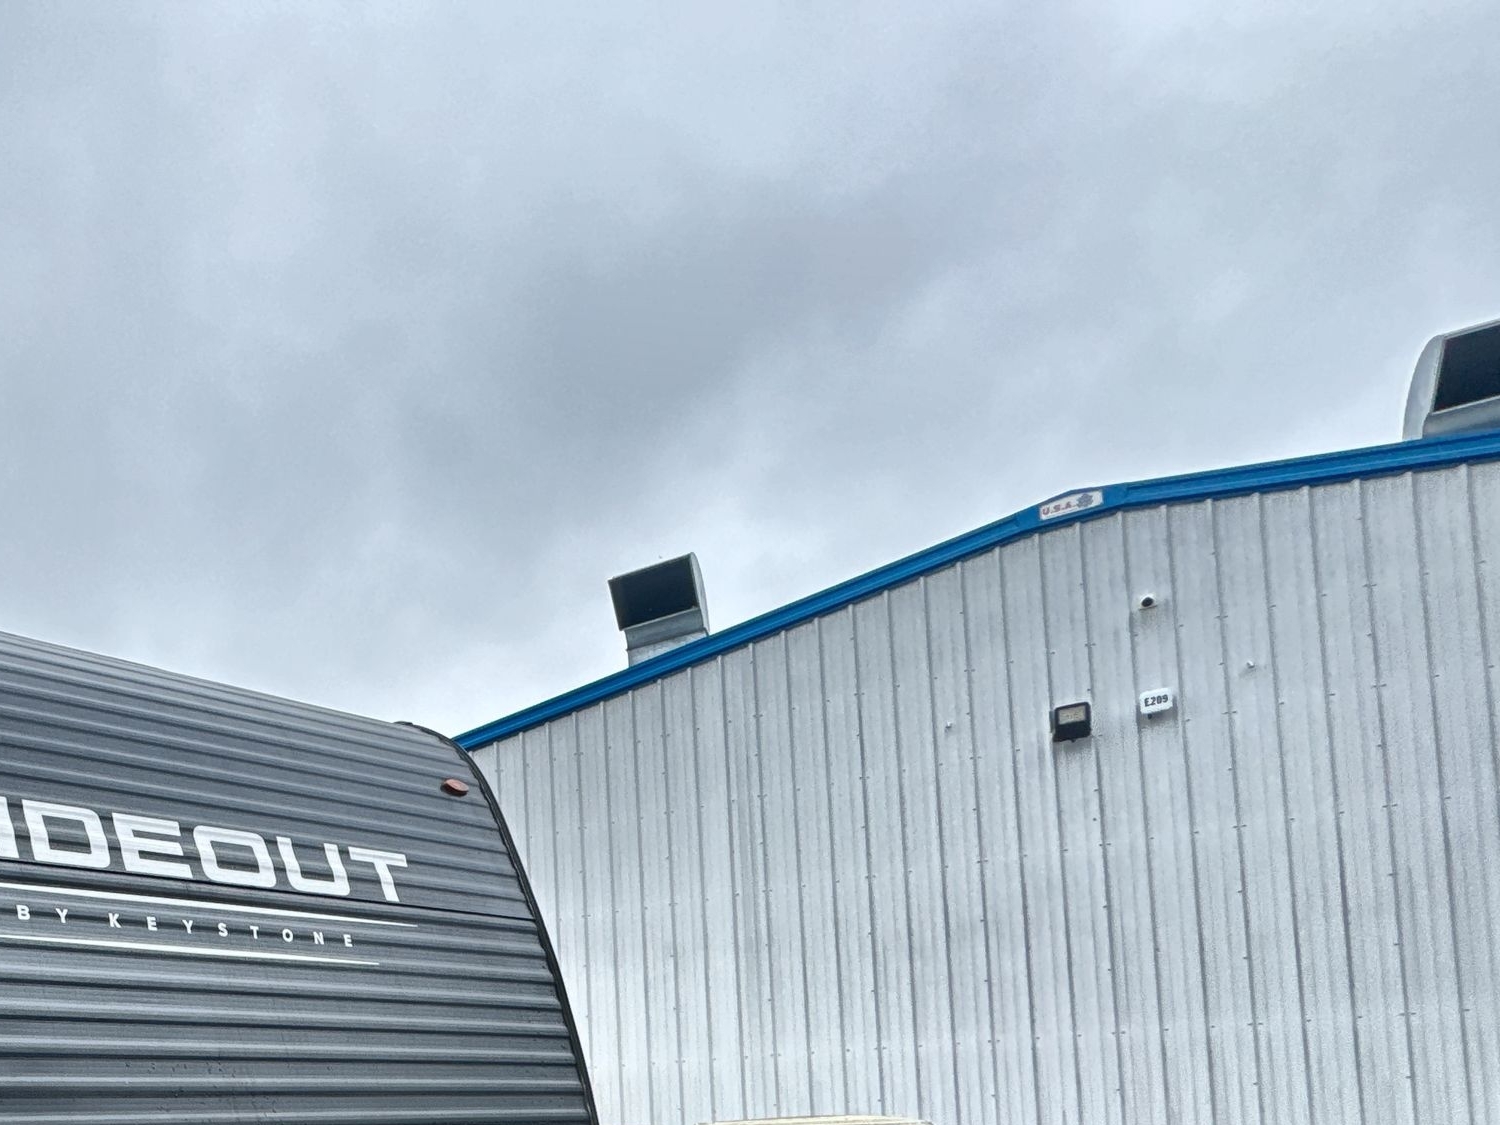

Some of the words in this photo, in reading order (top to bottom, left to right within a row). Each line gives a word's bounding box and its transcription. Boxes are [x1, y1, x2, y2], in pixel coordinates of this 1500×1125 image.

[1144, 693, 1169, 707] E209
[16, 904, 69, 924] BY
[108, 911, 354, 948] KEYSTONE
